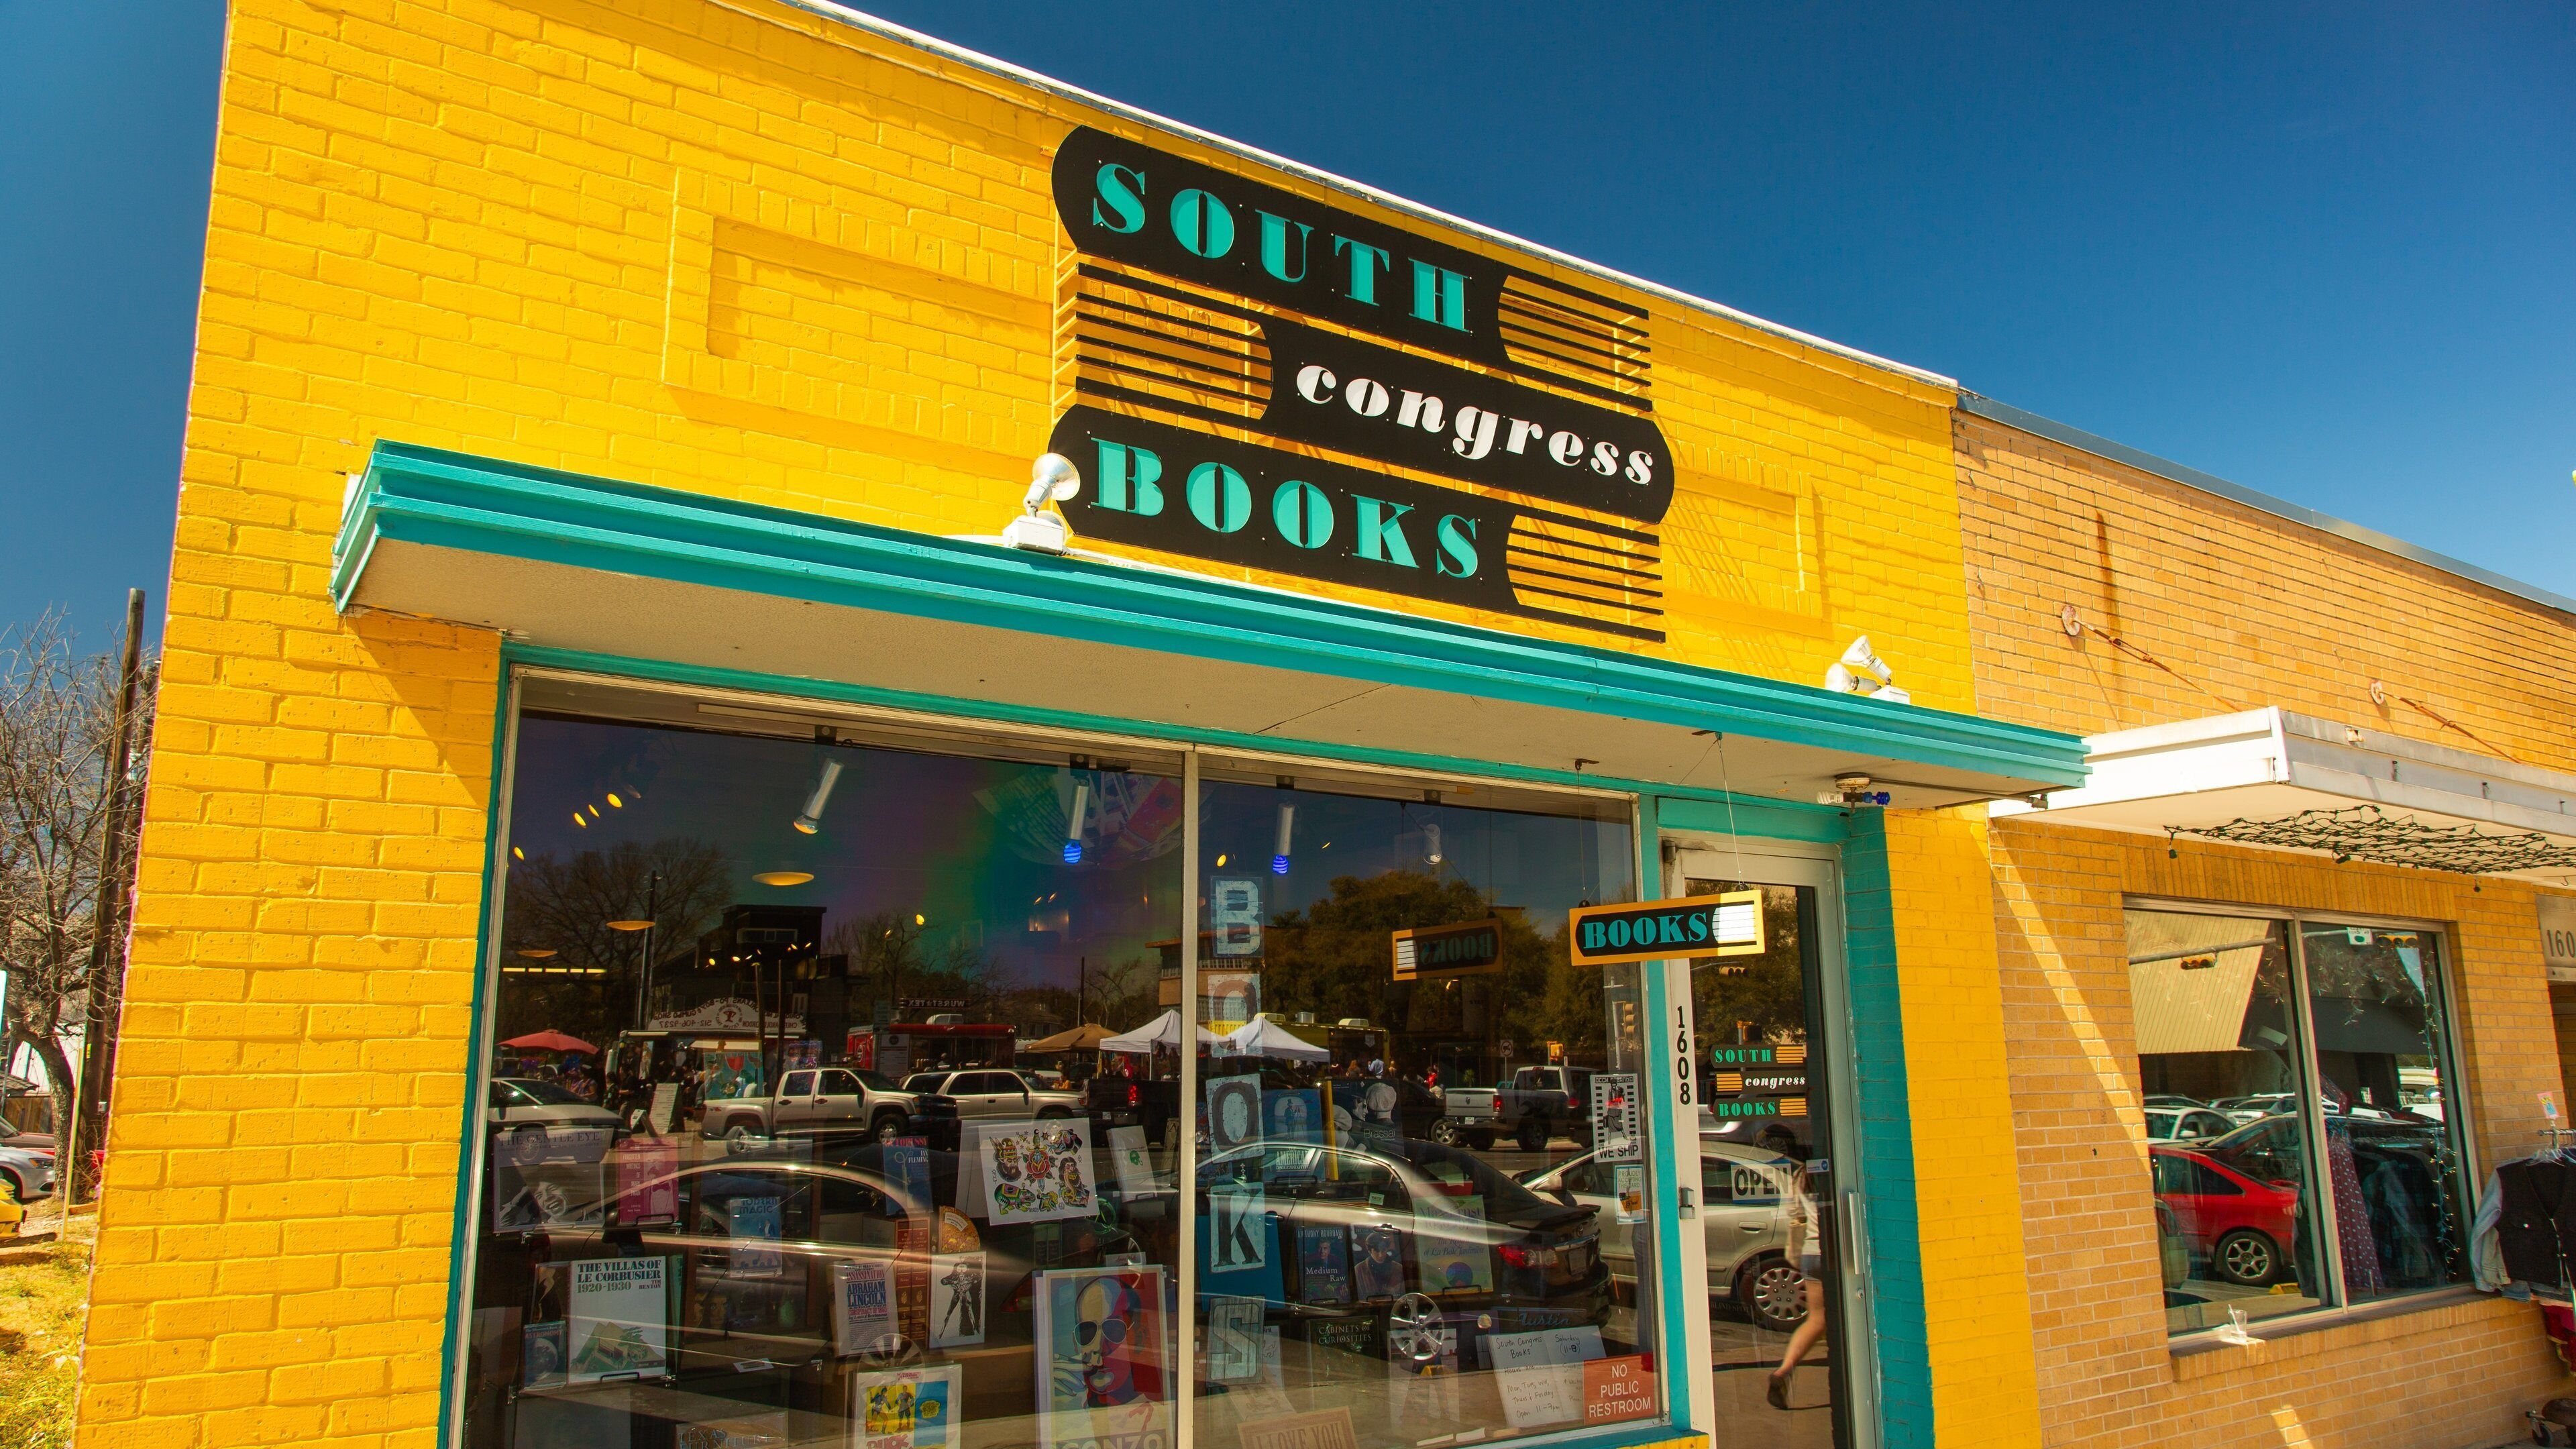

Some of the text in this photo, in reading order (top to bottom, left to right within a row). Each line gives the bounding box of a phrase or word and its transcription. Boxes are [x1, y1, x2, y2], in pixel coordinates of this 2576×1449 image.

[1093, 162, 1472, 333] SOUTH
[1297, 364, 1653, 485] congress
[1090, 437, 1479, 579] BOOKS
[1582, 912, 1708, 949] BOOKS
[1677, 1006, 1690, 1106] 1608
[1715, 1049, 1772, 1063] SOUTH
[1745, 1076, 1806, 1089] congress
[1718, 1101, 1776, 1117] BOOKS
[499, 1132, 600, 1146] THE GENTLE EYE
[1598, 1144, 1639, 1159] WE SHIP
[1734, 1167, 1789, 1196] OPEN
[739, 1206, 773, 1215] MAGIC
[1297, 1228, 1344, 1238] ANTHONY BOURDAIN
[578, 1259, 661, 1273] THE VILLAS OF
[1305, 1267, 1338, 1275] Medium
[578, 1269, 661, 1283] LE CORBUSIER
[577, 1281, 632, 1293] 1920-1930
[847, 1281, 885, 1294] ABRAHAM
[847, 1292, 886, 1307] LINCOLN
[1519, 1311, 1570, 1327] Austin
[525, 1330, 562, 1338] ASTRONOMY
[1319, 1324, 1359, 1335] CABINETS
[1318, 1333, 1372, 1344] CURIOSITIES
[1495, 1335, 1543, 1350] South Congress
[1555, 1334, 1580, 1345] Saturday
[1510, 1349, 1531, 1359] Books
[1611, 1364, 1627, 1379] NO
[1534, 1391, 1554, 1399] Friday
[1600, 1381, 1640, 1398] PUBLIC
[1589, 1396, 1651, 1418] RESTROOM
[1516, 1409, 1531, 1421] Open
[678, 1428, 727, 1442] TEXAS
